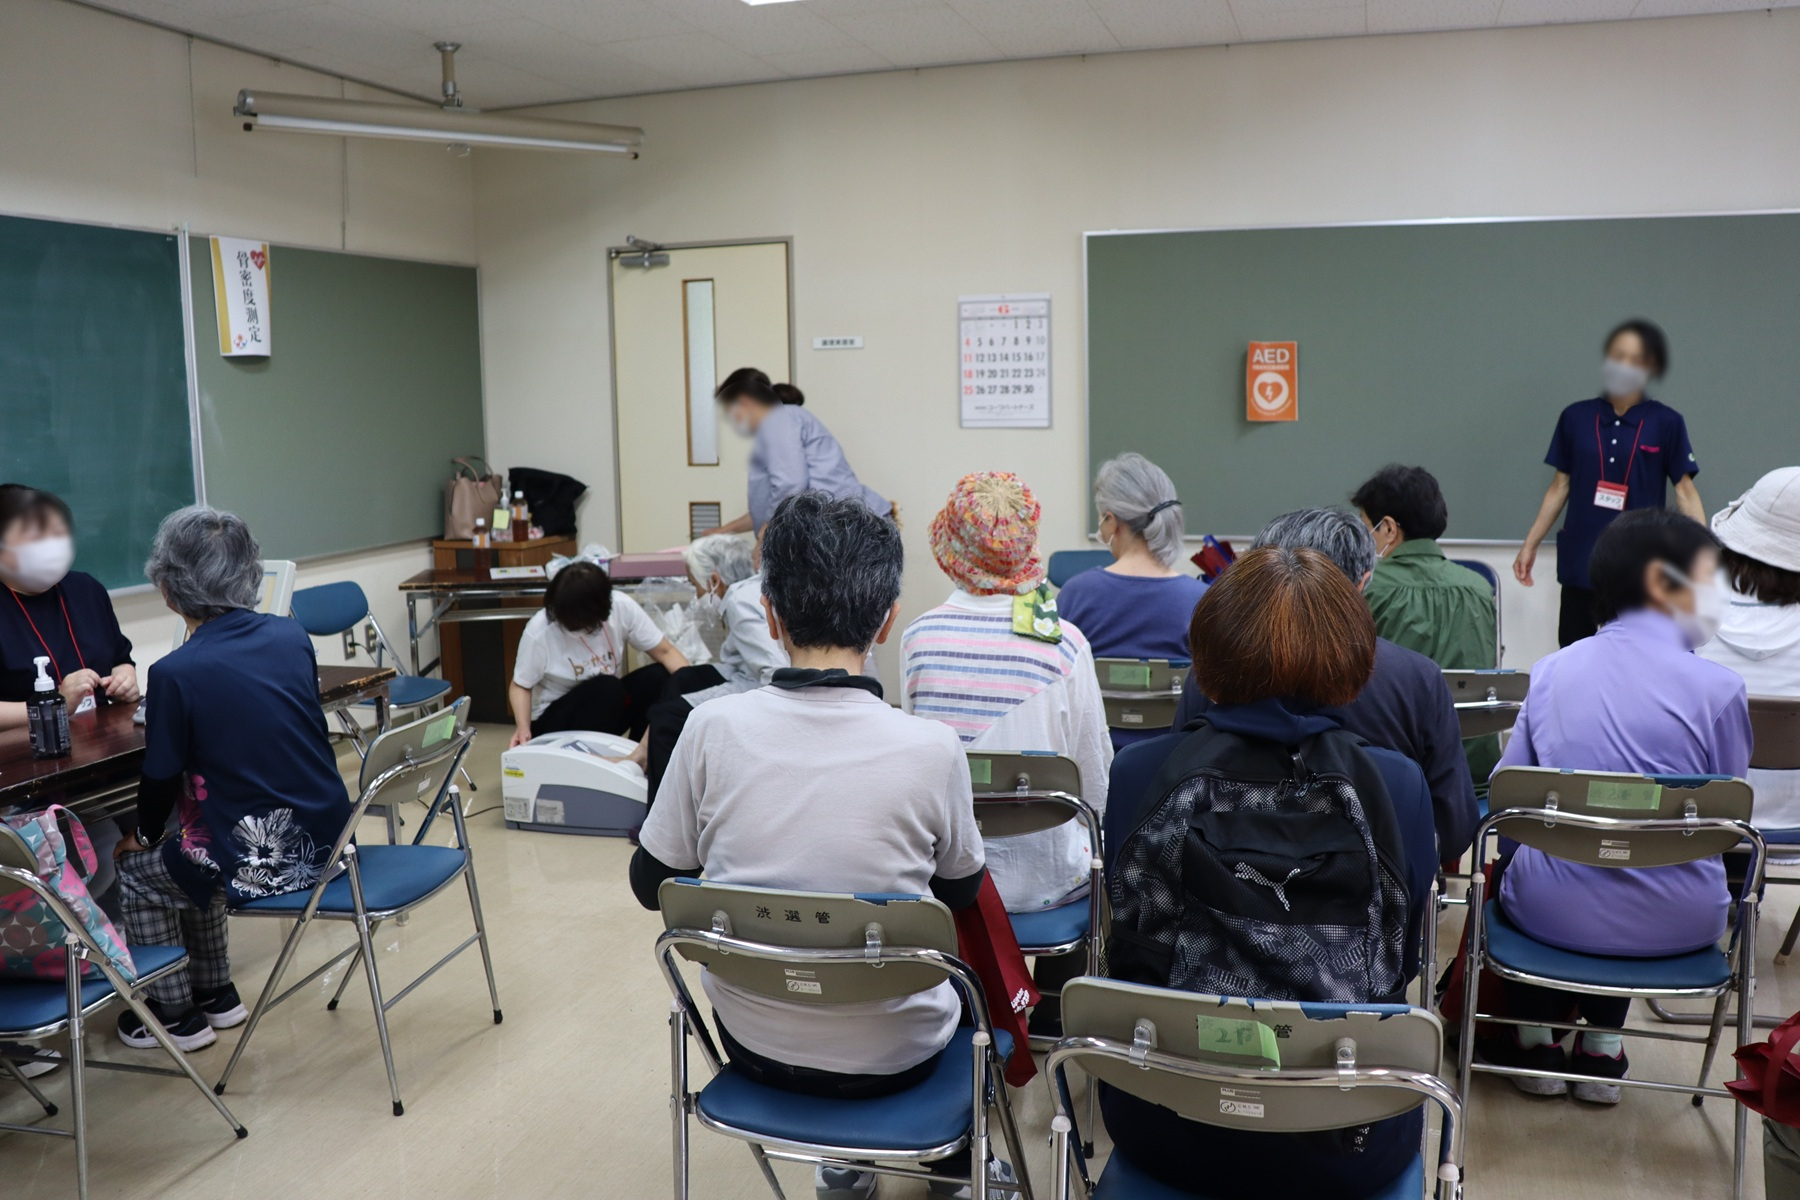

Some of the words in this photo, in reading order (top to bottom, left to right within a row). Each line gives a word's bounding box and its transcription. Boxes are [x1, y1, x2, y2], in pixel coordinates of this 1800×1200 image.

[236, 250, 262, 343] 骨密度測定
[1026, 319, 1031, 330] 2
[977, 336, 983, 347] 5
[989, 337, 994, 347] 6
[1001, 336, 1007, 346] 7
[1013, 336, 1019, 346] 8
[1026, 335, 1031, 345] 9
[963, 353, 973, 363] 11
[975, 353, 985, 363] 12
[987, 352, 997, 362] 13
[999, 352, 1009, 362] 14
[1012, 352, 1021, 362] 15
[1024, 351, 1034, 361] 16
[1253, 348, 1290, 364] AED
[963, 369, 973, 379] 18
[975, 369, 985, 379] 19
[987, 369, 998, 379] 20
[1000, 369, 1009, 378] 21
[1011, 368, 1022, 378] 22
[1024, 368, 1034, 378] 23
[963, 385, 973, 395] 25
[975, 385, 985, 395] 26
[987, 384, 997, 394] 27
[999, 384, 1010, 394] 28
[1012, 384, 1022, 394] 29
[1024, 384, 1034, 394] 30
[1598, 494, 1622, 505] スタッフ
[755, 905, 831, 924] 渋選管
